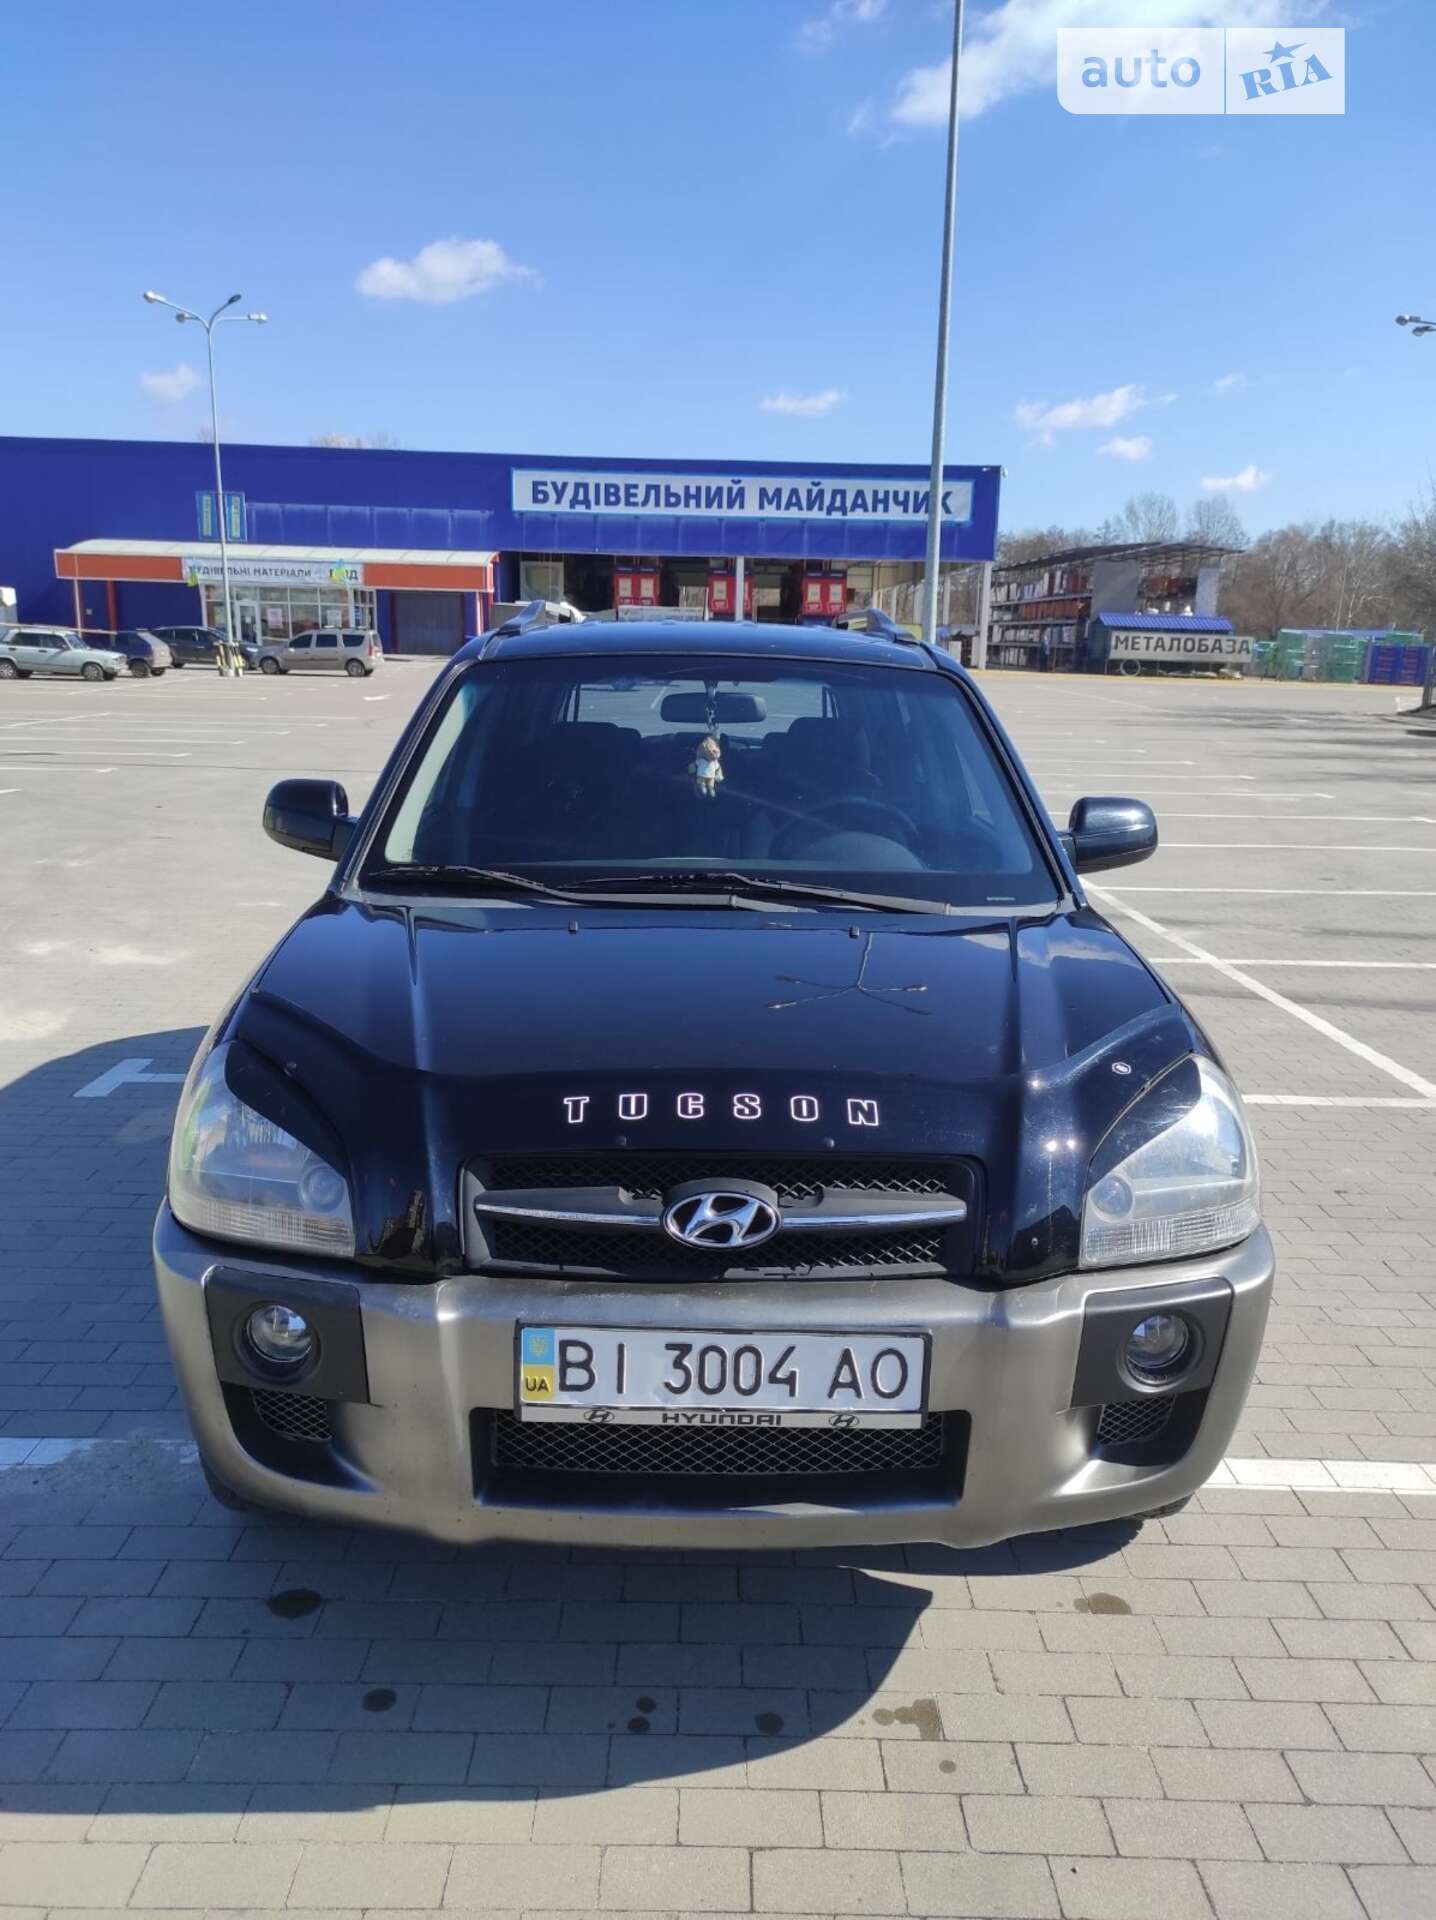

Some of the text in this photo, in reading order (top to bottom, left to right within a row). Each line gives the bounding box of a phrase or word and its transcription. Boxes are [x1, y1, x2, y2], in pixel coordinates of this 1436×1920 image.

[531, 478, 953, 517] БУДІВЕЛЬНИЙ МАЙДАНЧИК
[253, 567, 312, 578] МАТЕРІАЛИ
[1113, 634, 1251, 655] МЕТАЛОБАЗА
[563, 1092, 880, 1126] TUCSON
[558, 1339, 909, 1400] BI 3004 AO
[525, 1377, 551, 1392] UA
[661, 1411, 783, 1428] HYUNDAI
